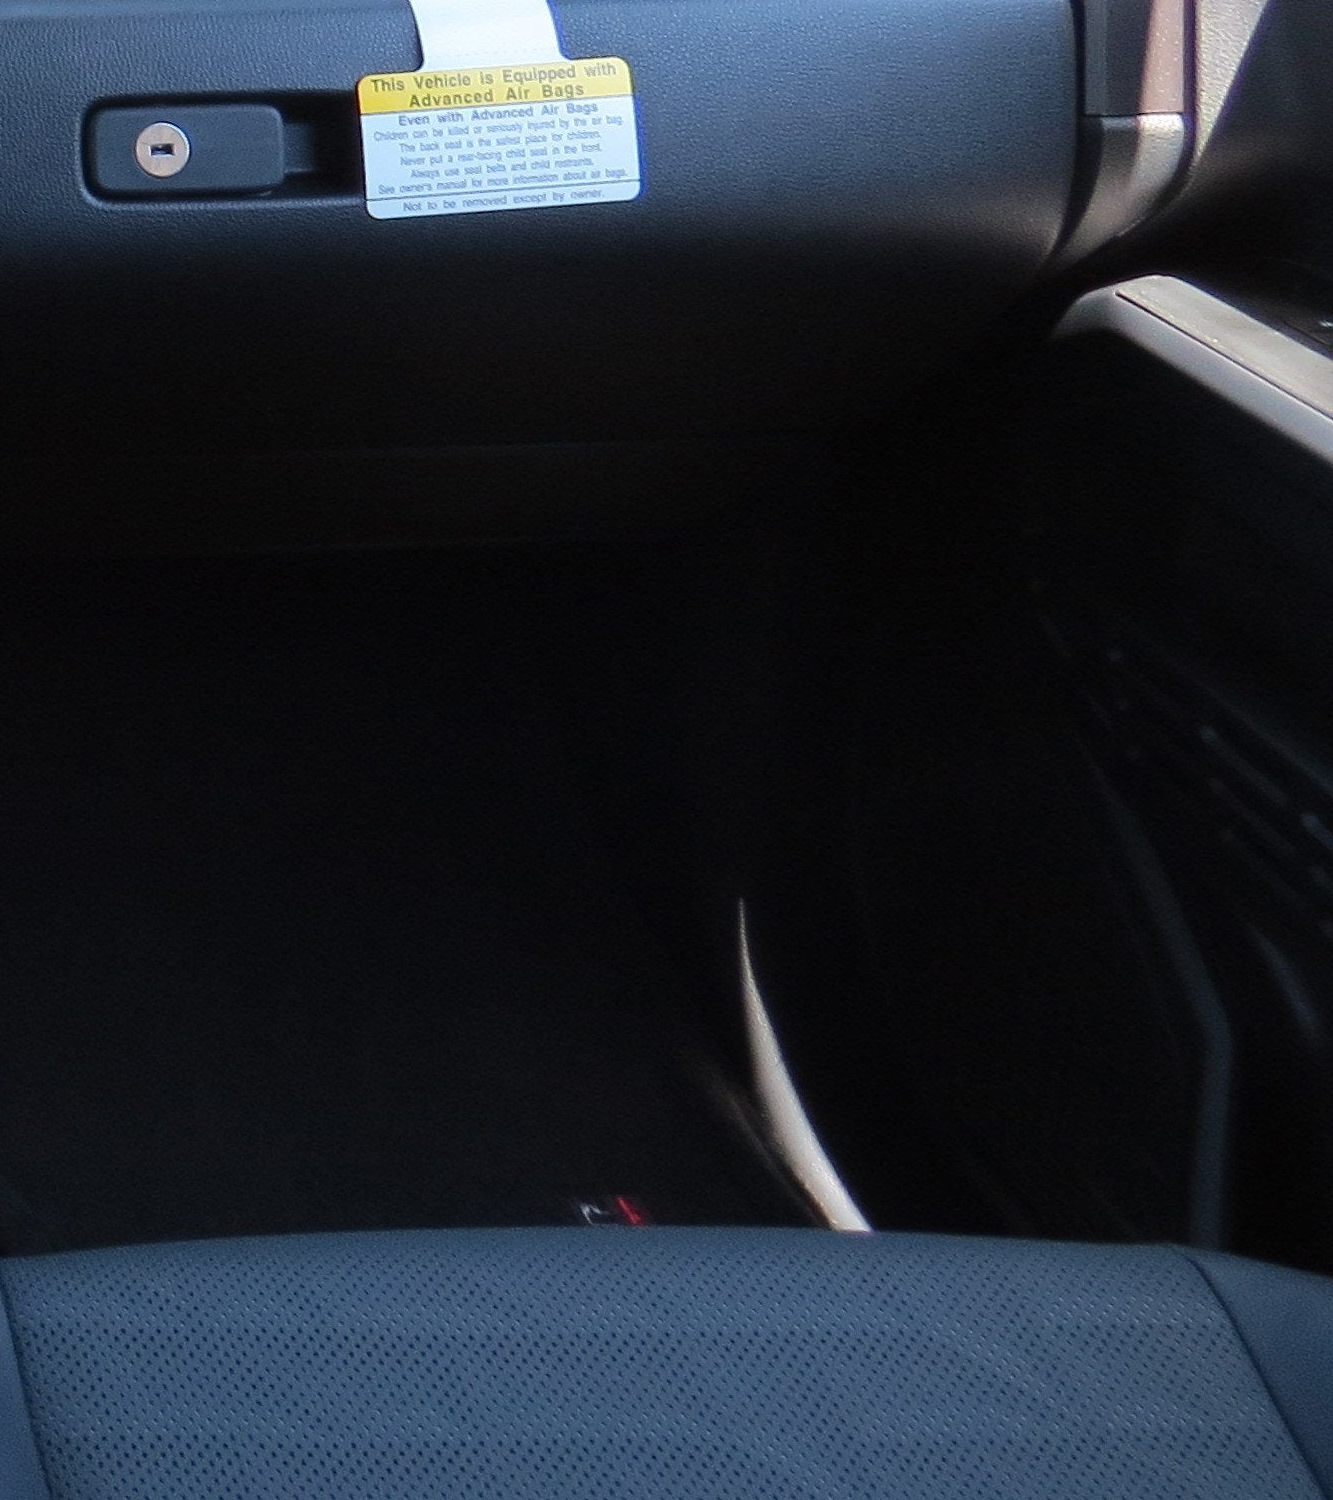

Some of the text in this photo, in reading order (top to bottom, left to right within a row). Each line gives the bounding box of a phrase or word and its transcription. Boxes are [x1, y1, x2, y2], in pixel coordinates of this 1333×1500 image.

[371, 63, 617, 93] This Vehicle is Equipped with
[409, 83, 585, 108] Advanced Air Bags
[398, 102, 598, 127] Even with Advanced Air Bags
[403, 201, 422, 212] Not
[427, 201, 437, 211] to
[443, 200, 456, 209] be
